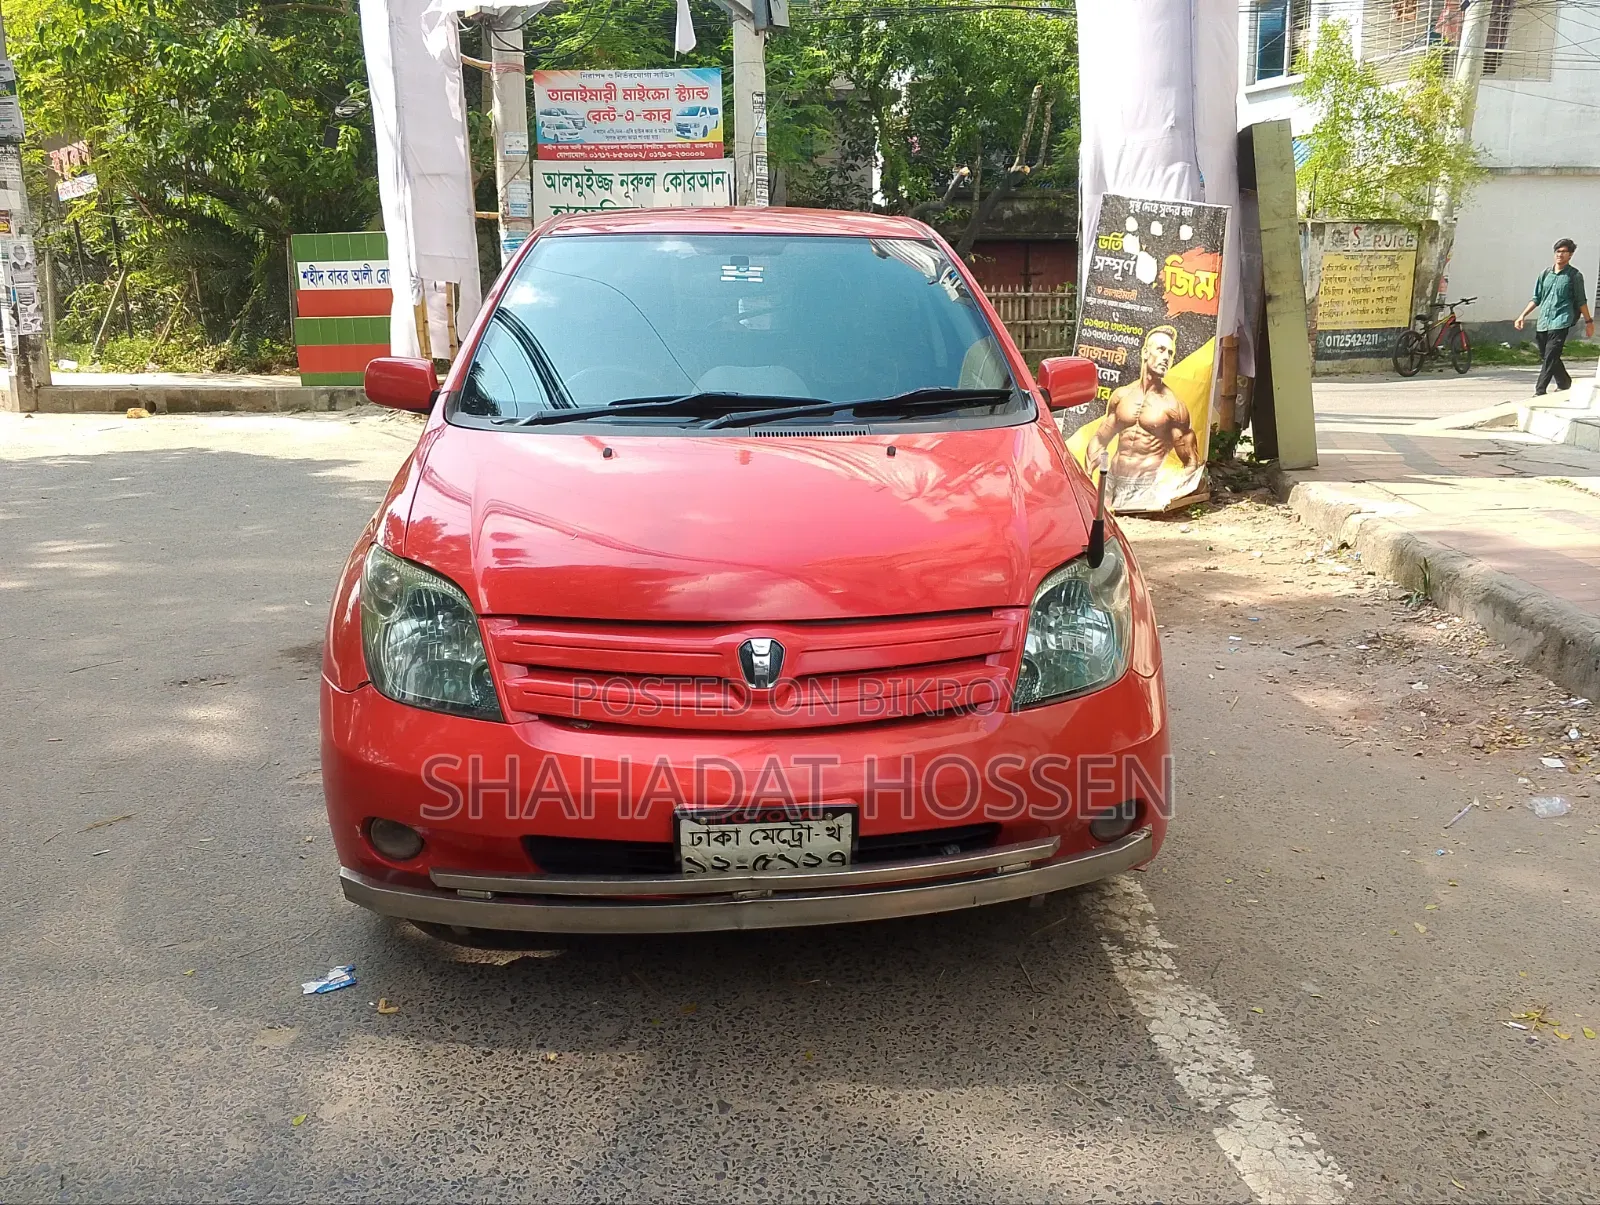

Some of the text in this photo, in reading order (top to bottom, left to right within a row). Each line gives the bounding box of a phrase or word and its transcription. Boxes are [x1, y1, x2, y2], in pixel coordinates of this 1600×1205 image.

[547, 83, 709, 103] তালাইমারী মাইক্রো স্ট্যান্ড
[587, 106, 671, 123] রেন্ট-এ-কার
[663, 168, 727, 194] কোরআন
[1142, 202, 1159, 213] দেহে
[1159, 205, 1181, 218] সুন্দর
[1181, 208, 1194, 217] মন
[1352, 226, 1415, 248] SERVICE
[301, 263, 390, 288] শহীদ বাবর আলী রো
[1163, 254, 1219, 301] জিম
[1325, 334, 1379, 347] 01725424211
[1078, 344, 1128, 366] রাজশাহী
[688, 825, 741, 847] ঢাকা
